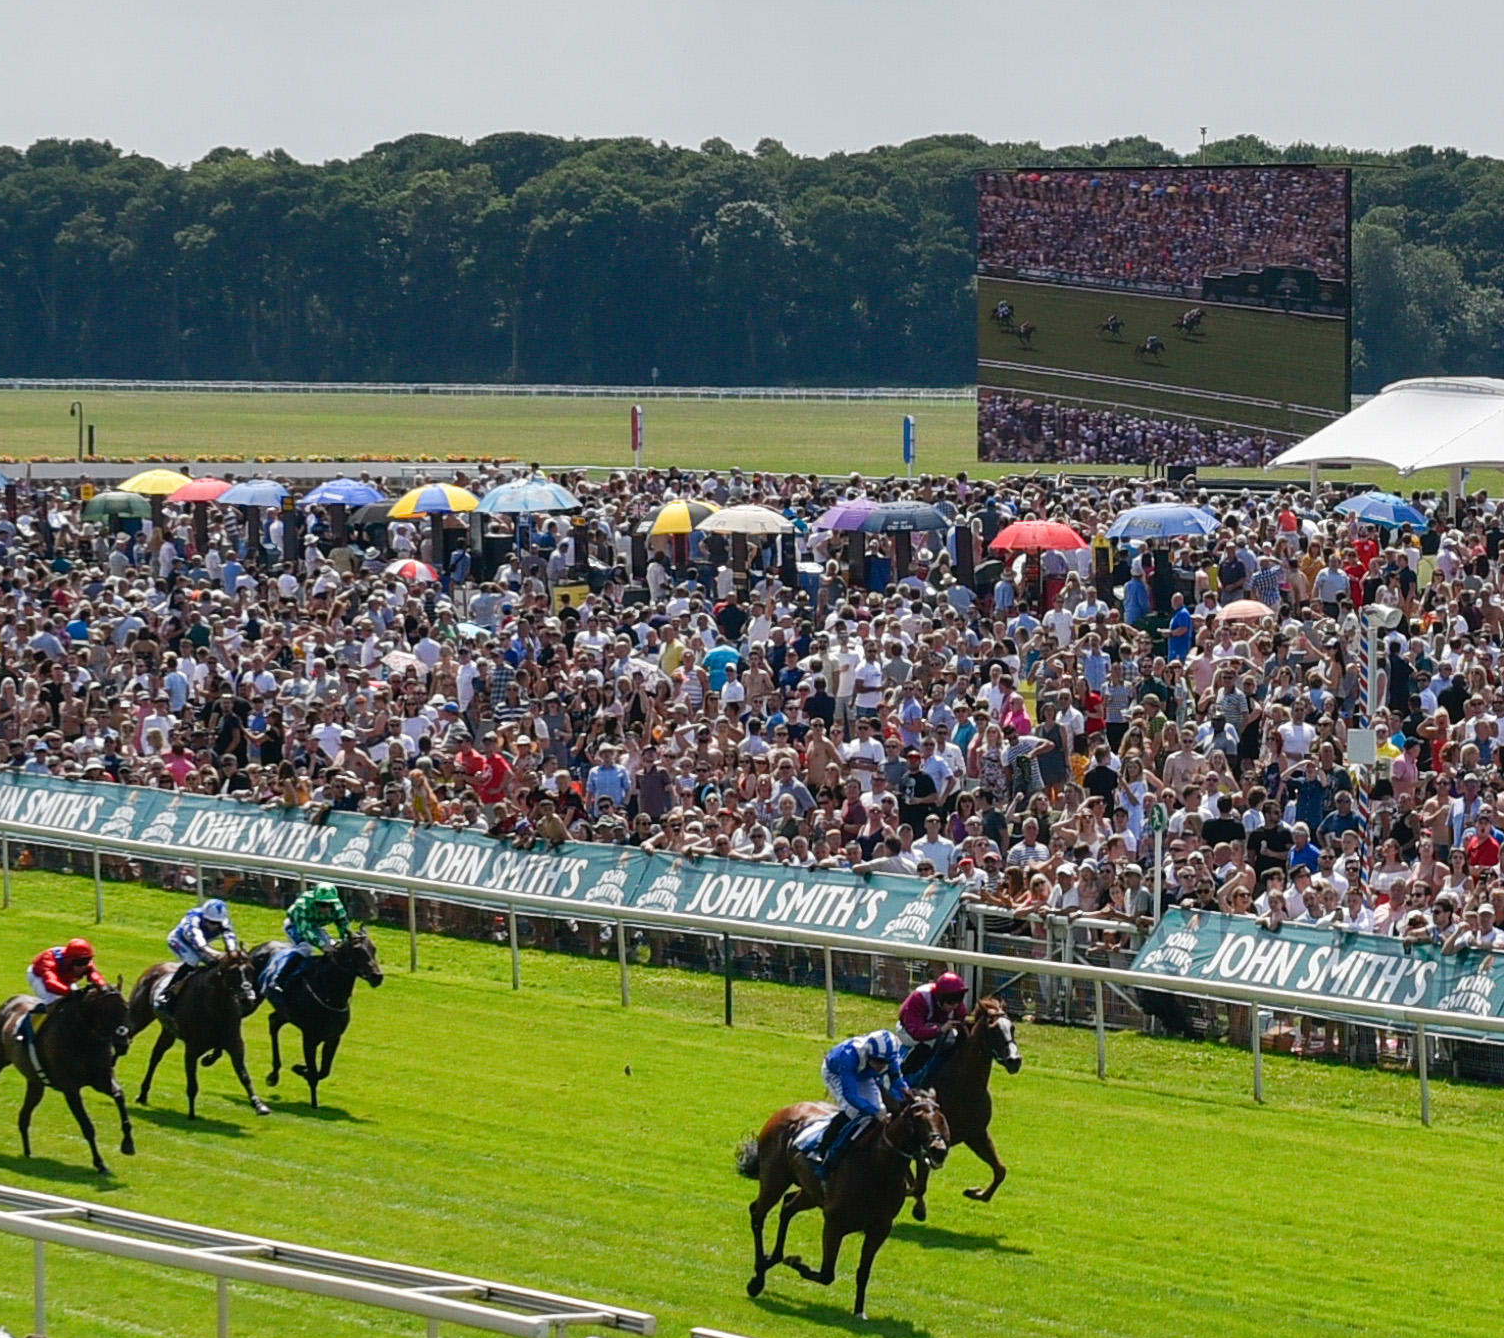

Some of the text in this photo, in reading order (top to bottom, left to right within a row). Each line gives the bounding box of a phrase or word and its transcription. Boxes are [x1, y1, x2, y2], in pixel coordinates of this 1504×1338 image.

[20, 788, 104, 832] SMITH'S
[179, 810, 249, 851] JOHN
[245, 817, 337, 862] SMITH'S
[417, 841, 588, 898] JOHN SMITH'S
[597, 869, 628, 888] JOHN
[648, 874, 682, 893] JOHN
[685, 873, 888, 931] JOHN SMITH'S
[898, 899, 935, 920] JOHN
[1164, 932, 1198, 954] JOHN
[1202, 932, 1438, 1007] JOHN SMITH'S
[1454, 973, 1495, 998] JOHN
